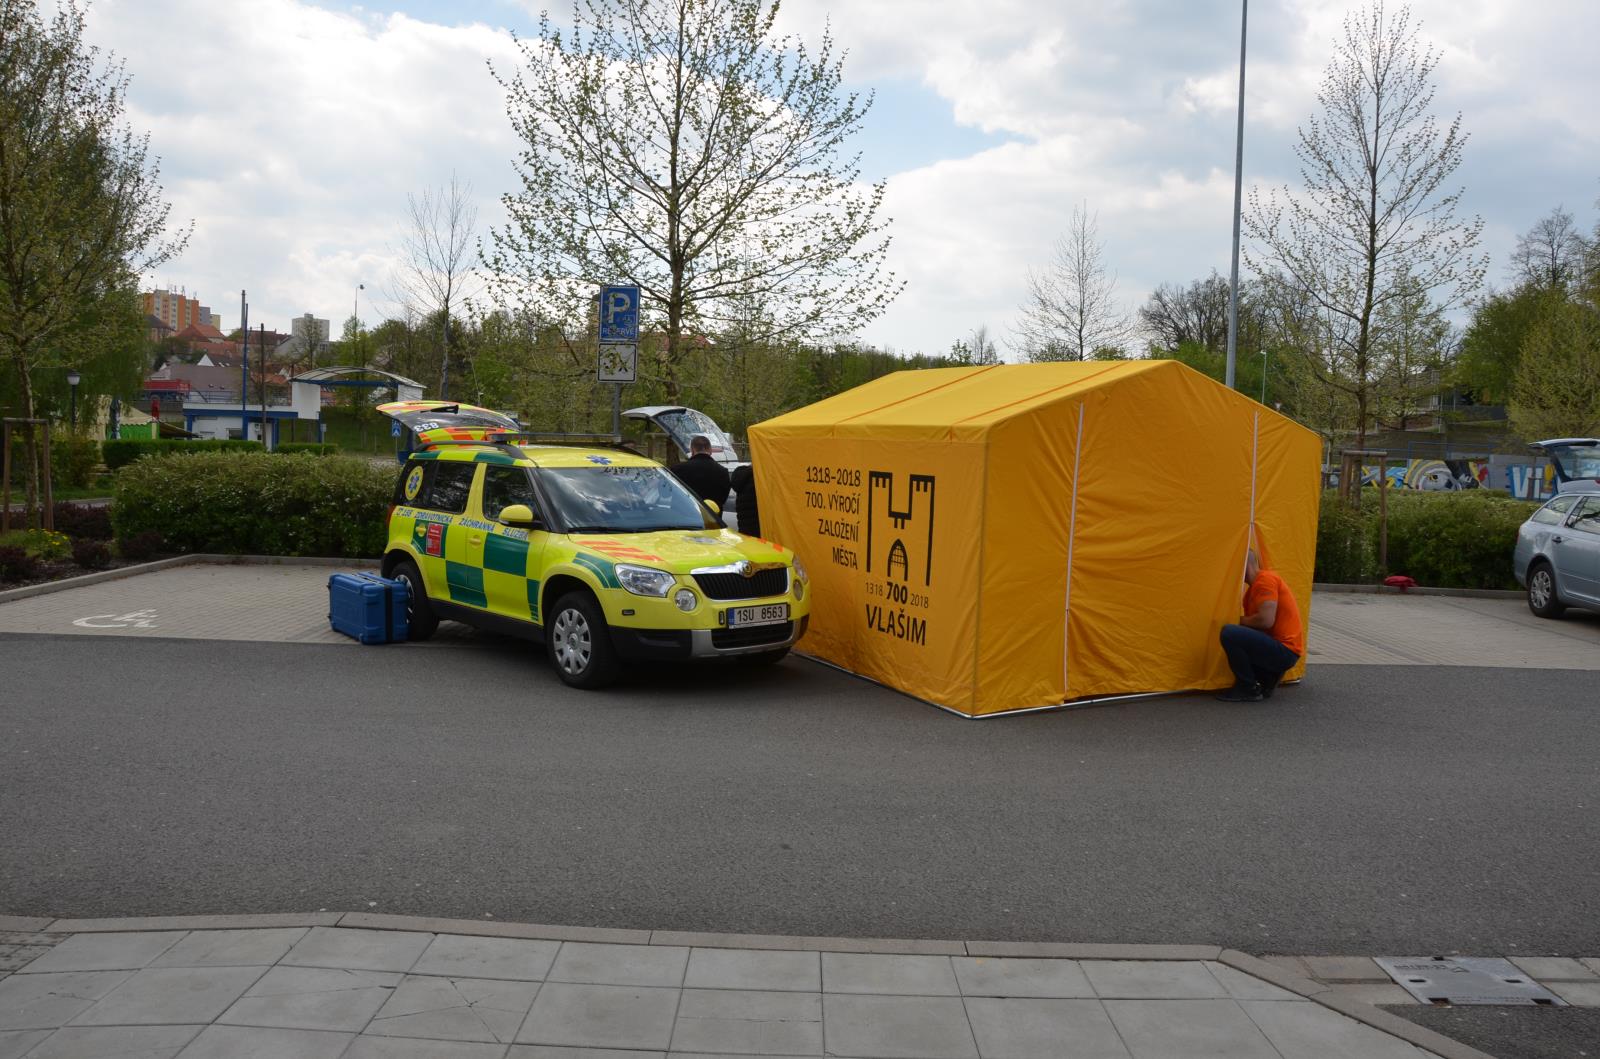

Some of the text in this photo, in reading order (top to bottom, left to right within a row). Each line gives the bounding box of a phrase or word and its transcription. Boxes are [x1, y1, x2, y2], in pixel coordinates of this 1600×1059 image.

[608, 292, 631, 324] P
[805, 490, 861, 515] 700. VÝROČÍ
[818, 518, 860, 543] ZALOŽENÍ
[832, 545, 859, 570] MĚSTA
[865, 581, 929, 609] 1318 700 2018
[737, 606, 783, 622] 1SU 8563
[866, 603, 927, 646] VLAŠIM
